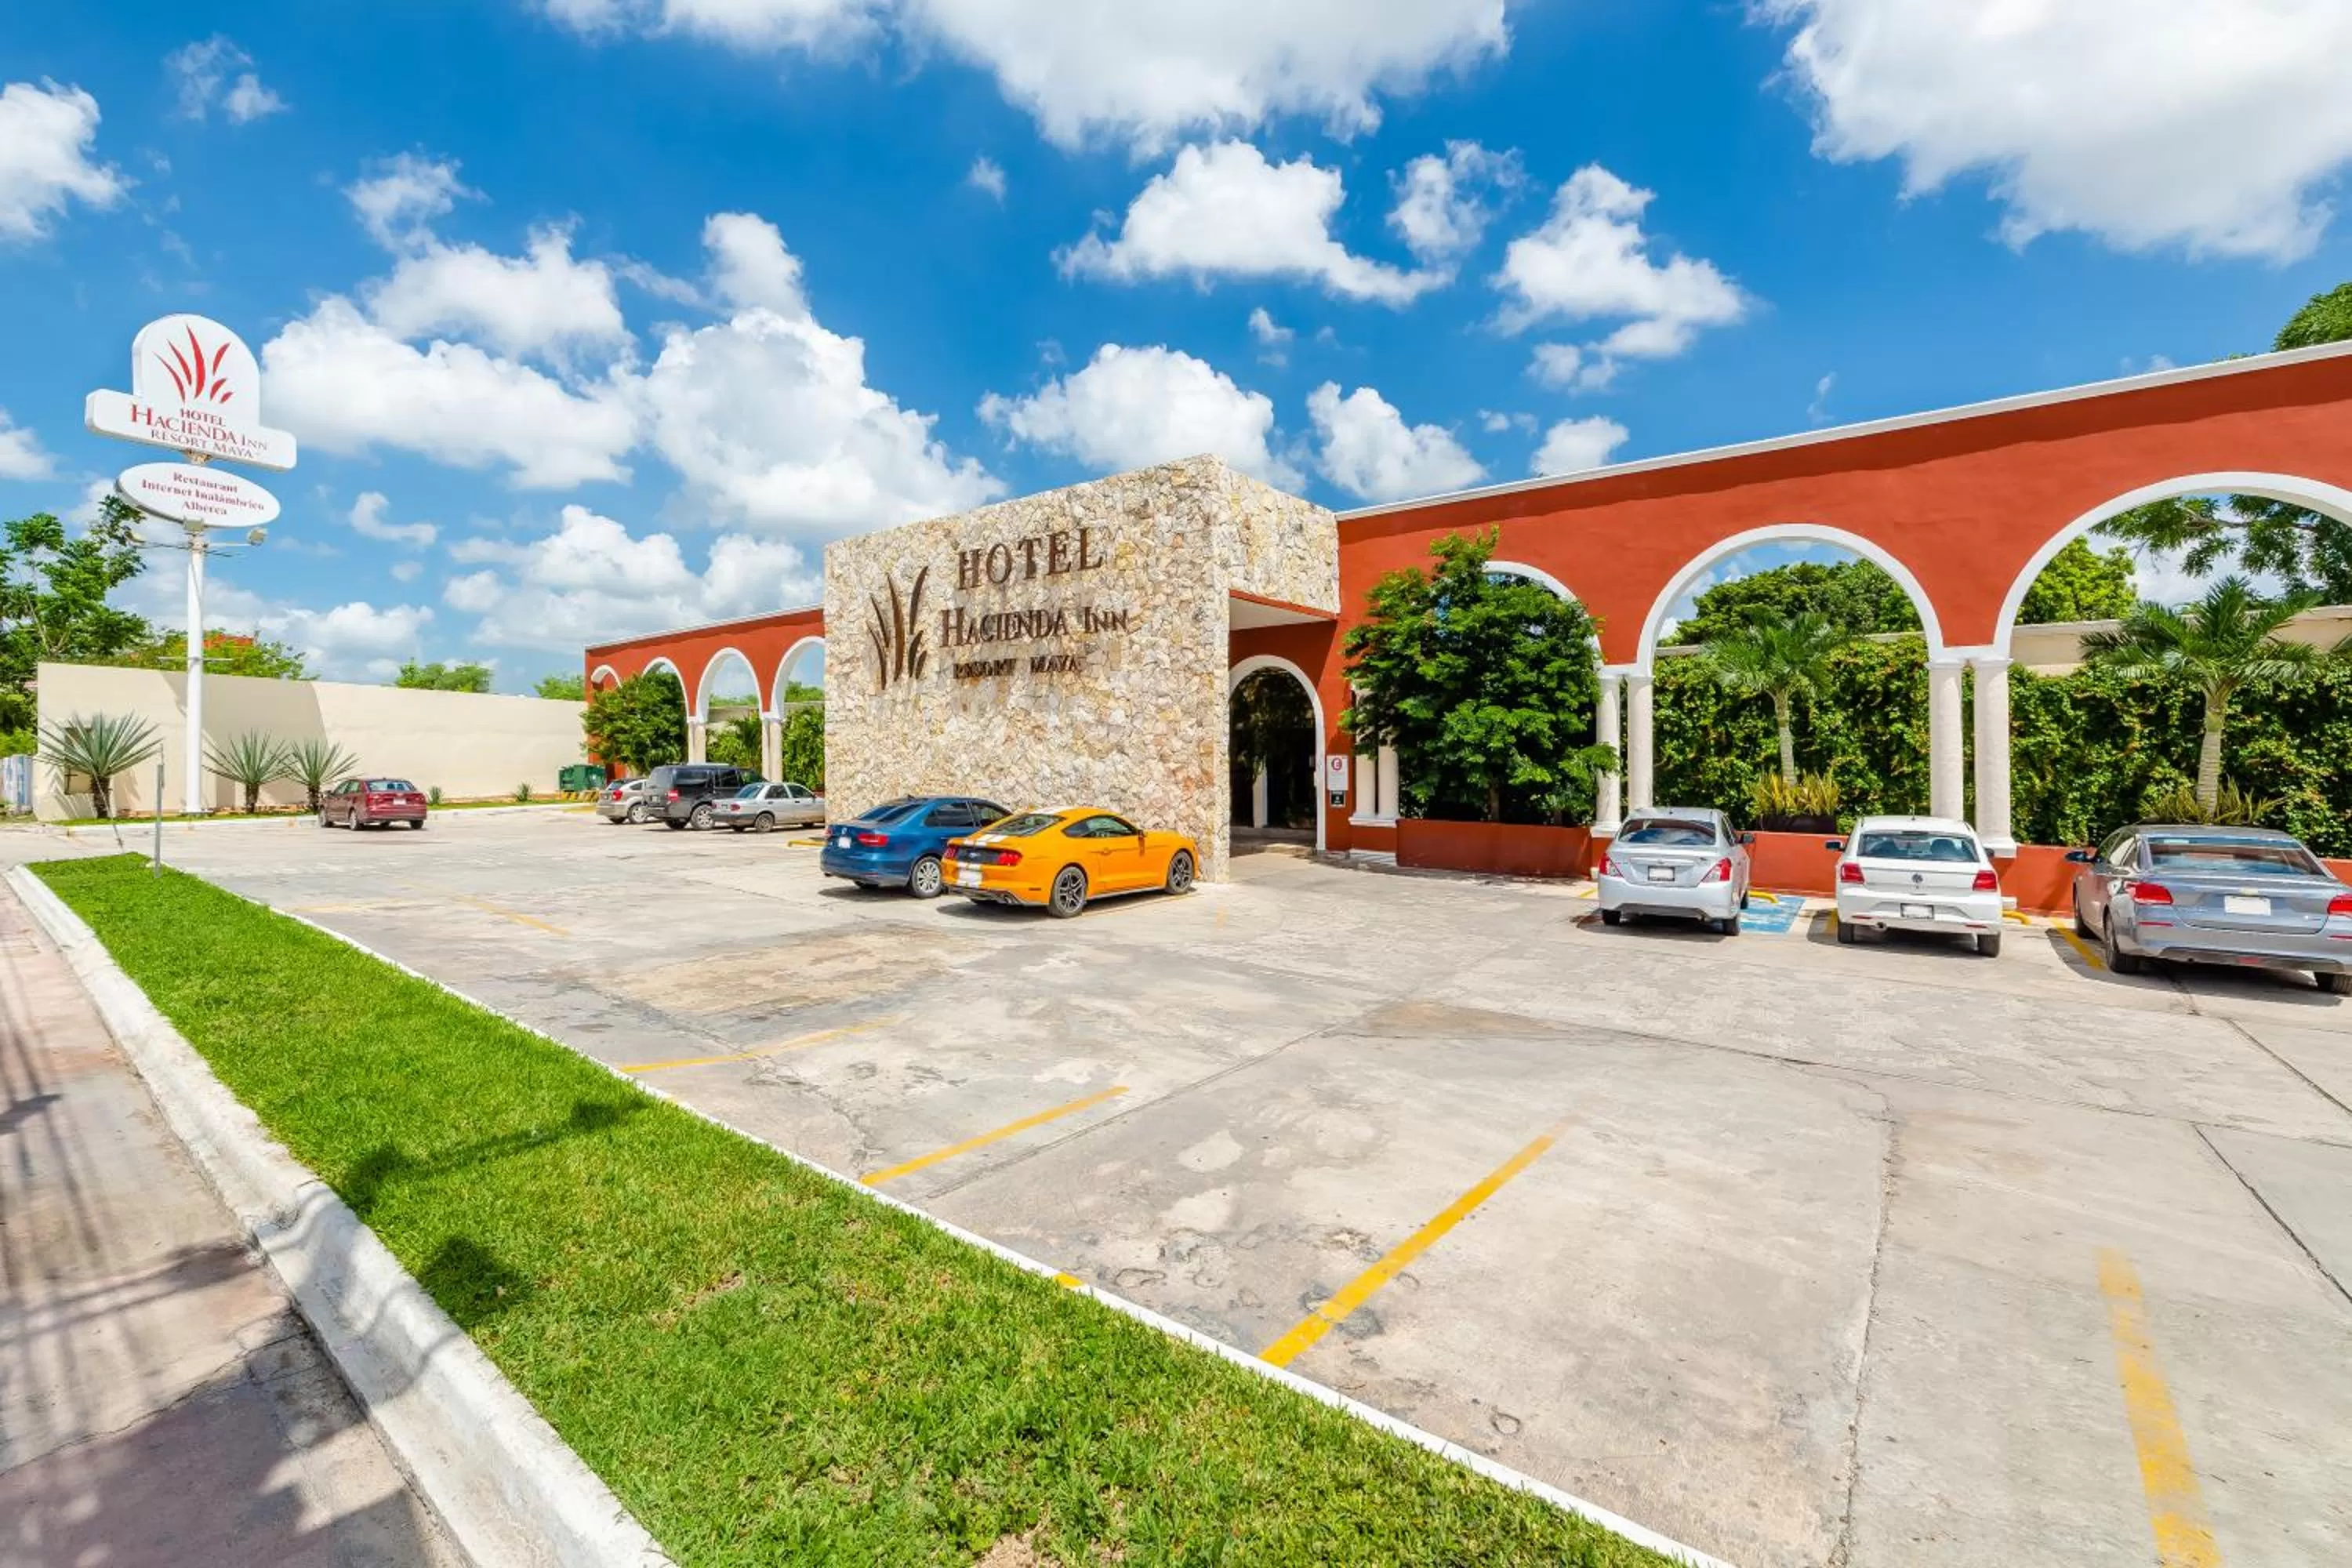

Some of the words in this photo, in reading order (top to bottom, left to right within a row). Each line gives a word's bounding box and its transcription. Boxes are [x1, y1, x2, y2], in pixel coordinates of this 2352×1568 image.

[131, 404, 236, 445] HACIENDA
[241, 434, 267, 451] INN
[180, 408, 226, 426] HOTEL
[151, 429, 207, 449] RESORT
[213, 441, 254, 459] MAYA
[142, 479, 192, 496] Internet
[182, 500, 227, 515] Alberca
[958, 527, 1103, 590] HOTEL
[940, 607, 1069, 648] HACIENDA
[1083, 606, 1129, 633] INN
[1029, 655, 1080, 673] MAYA
